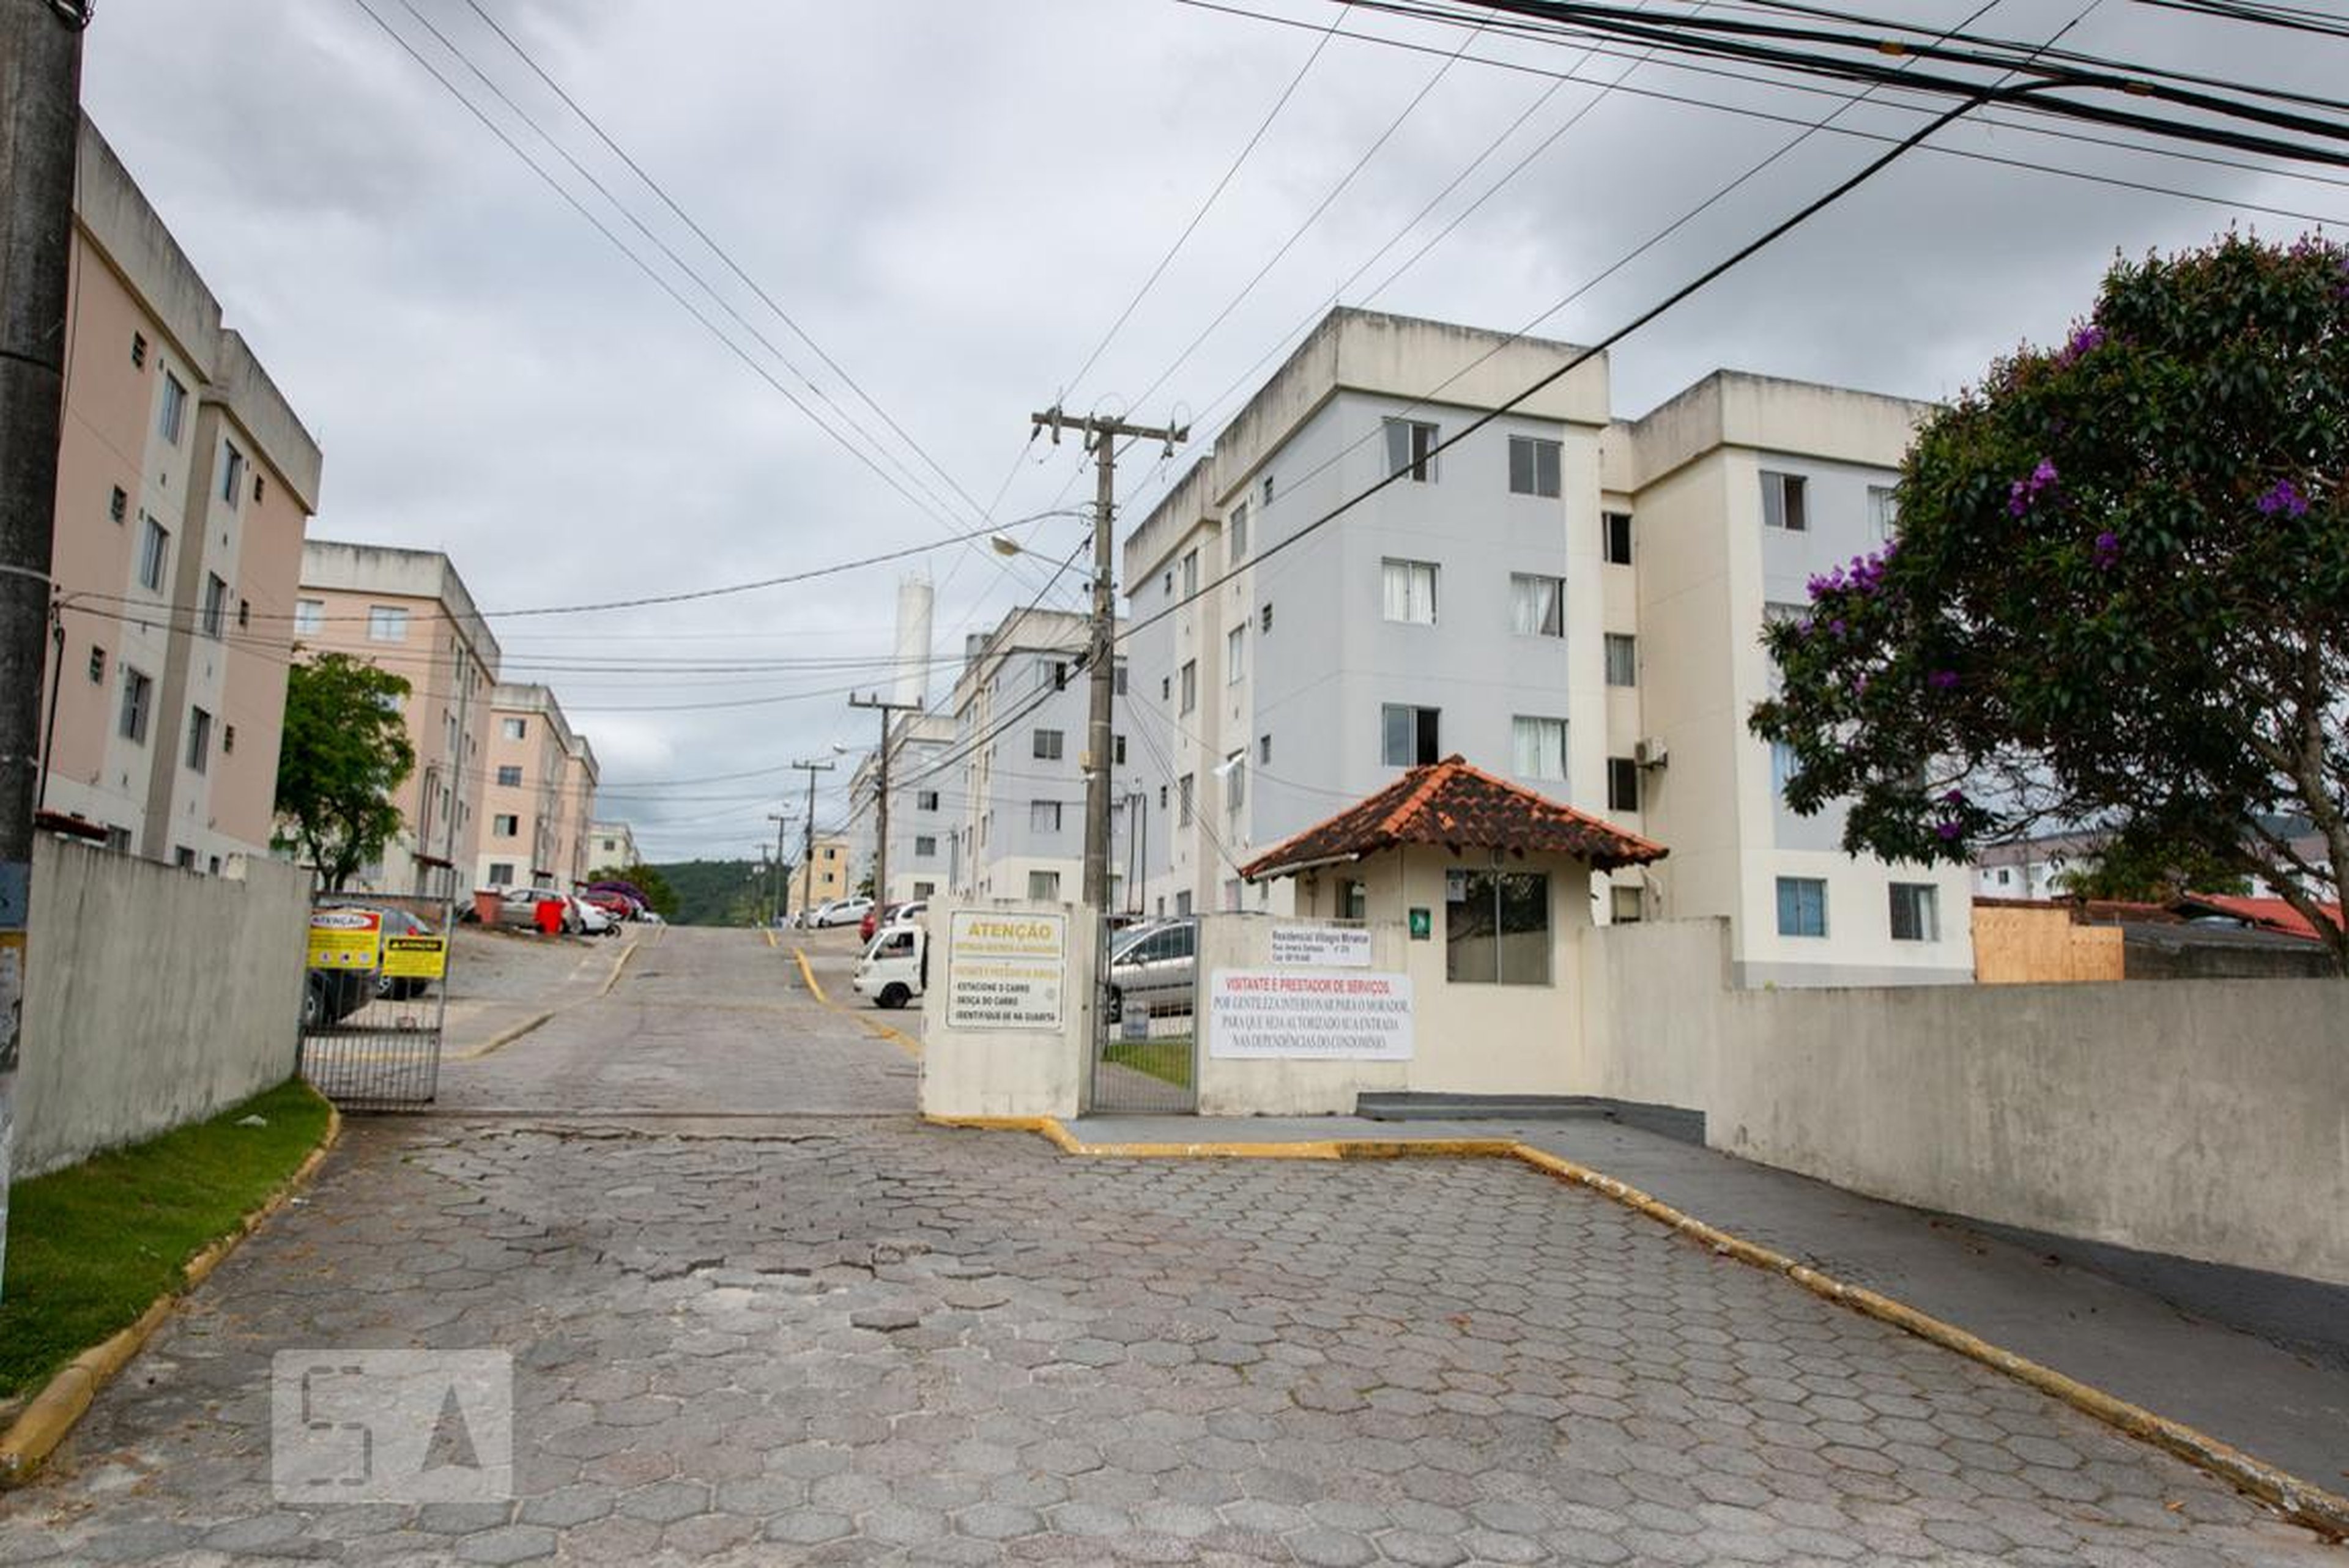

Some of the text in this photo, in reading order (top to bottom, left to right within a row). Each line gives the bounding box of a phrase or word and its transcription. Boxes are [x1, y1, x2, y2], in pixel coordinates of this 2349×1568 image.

[968, 922, 1052, 942] ATENÇÃO
[957, 982, 996, 991] ESTACIONE
[1006, 984, 1030, 993] CARRO
[1226, 977, 1269, 991] VISITANTE
[1272, 978, 1278, 991] E
[1280, 978, 1332, 993] PRESTADOR
[1334, 979, 1346, 994] DE
[982, 997, 992, 1005] DO
[995, 997, 1018, 1006] CARRO
[1233, 996, 1280, 1010] GENTILEZA
[1336, 998, 1357, 1010] PARA
[1223, 1015, 1244, 1029] PARA
[1245, 1016, 1262, 1031] QUE
[1265, 1016, 1285, 1029] SEJA
[1286, 1016, 1340, 1029] AUTORIZADO
[1231, 1034, 1251, 1047] NAS
[1318, 1035, 1330, 1048] DO
